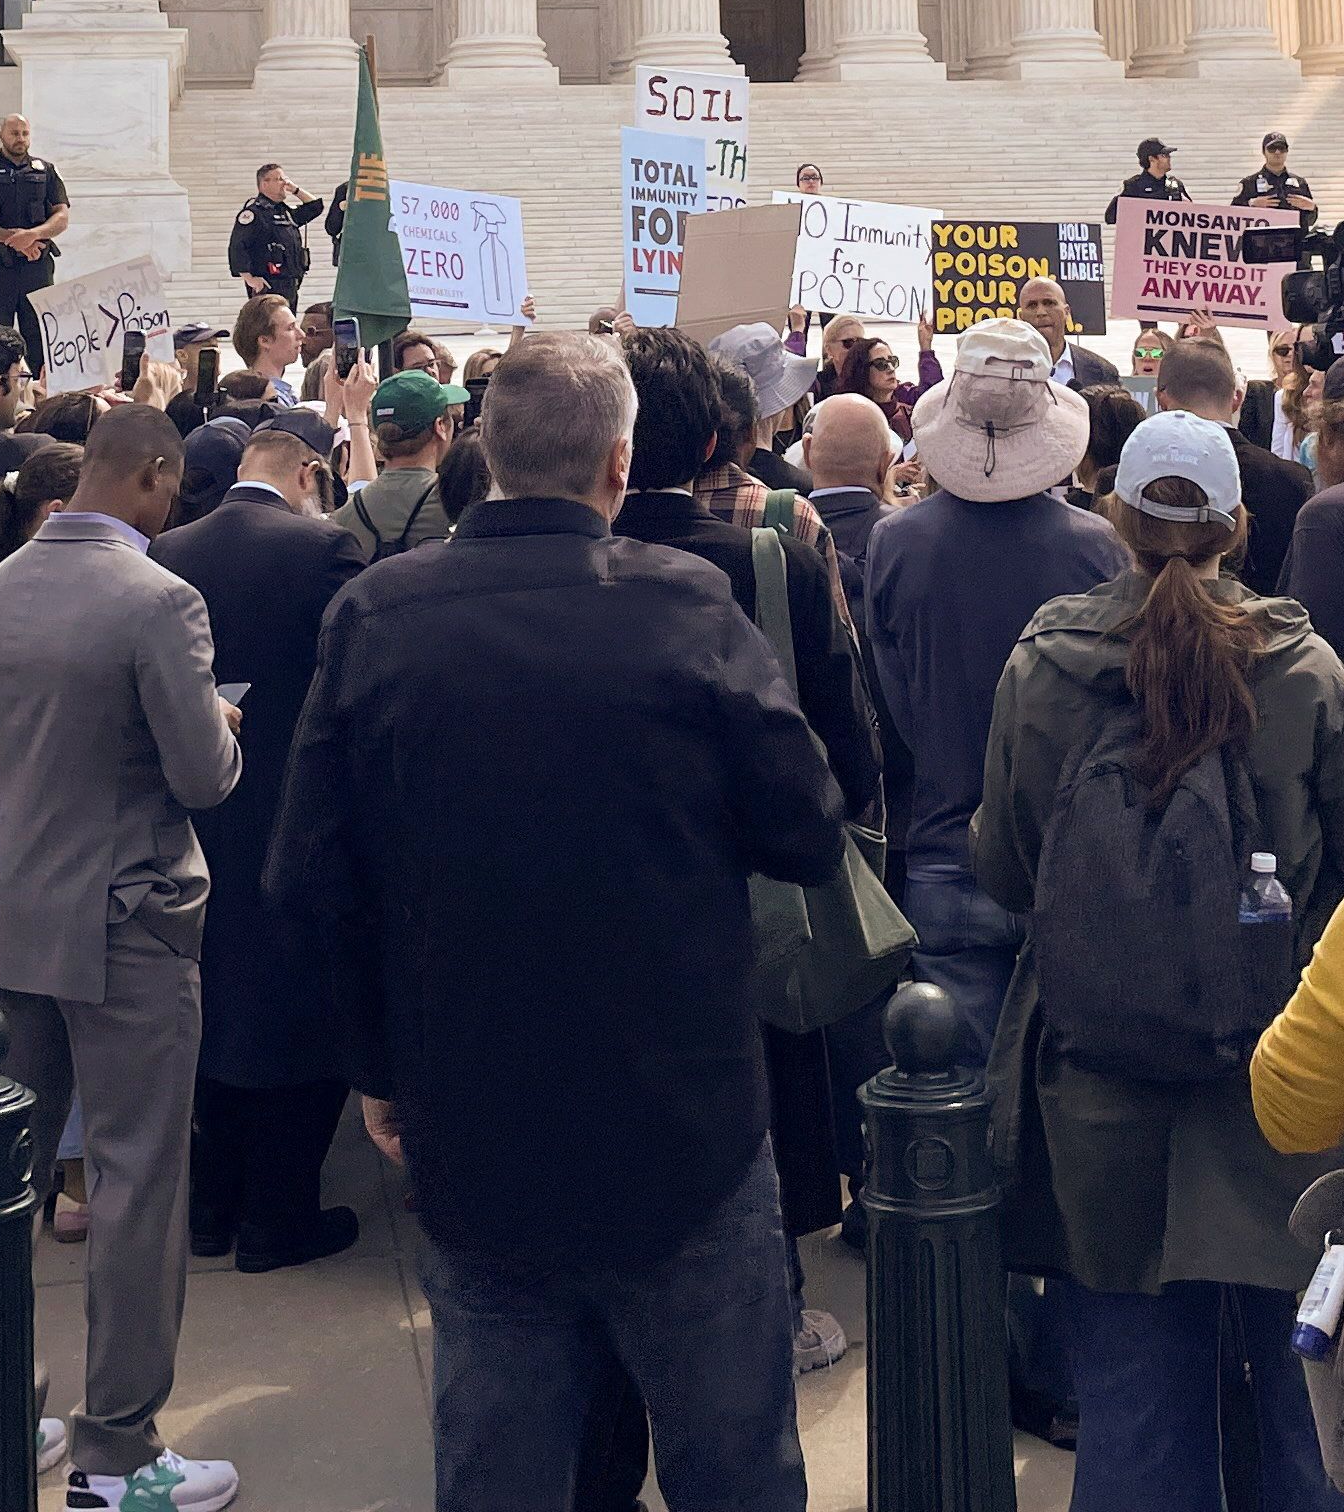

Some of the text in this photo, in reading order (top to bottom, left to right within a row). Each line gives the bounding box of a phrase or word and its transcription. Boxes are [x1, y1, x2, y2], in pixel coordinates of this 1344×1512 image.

[646, 75, 743, 122] SOIL
[355, 152, 387, 202] THE
[630, 157, 698, 188] TOTAL
[401, 196, 460, 221] 57,000
[631, 186, 698, 207] IMMUNITY
[834, 201, 933, 265] Immunity
[932, 223, 1019, 250] YOUR
[1058, 223, 1089, 242] HOLD
[405, 248, 464, 280] ZERO
[829, 247, 865, 277] for
[934, 251, 1057, 281] POISON.
[1059, 242, 1098, 261] BAYER
[1060, 262, 1104, 282] LIABLE!
[1143, 259, 1267, 283] THEY SOLD IT
[798, 270, 926, 321] POISON
[933, 279, 1017, 305] YOUR
[1141, 277, 1266, 307] ANYWAY.
[42, 310, 101, 373] People
[117, 292, 170, 331] Poison
